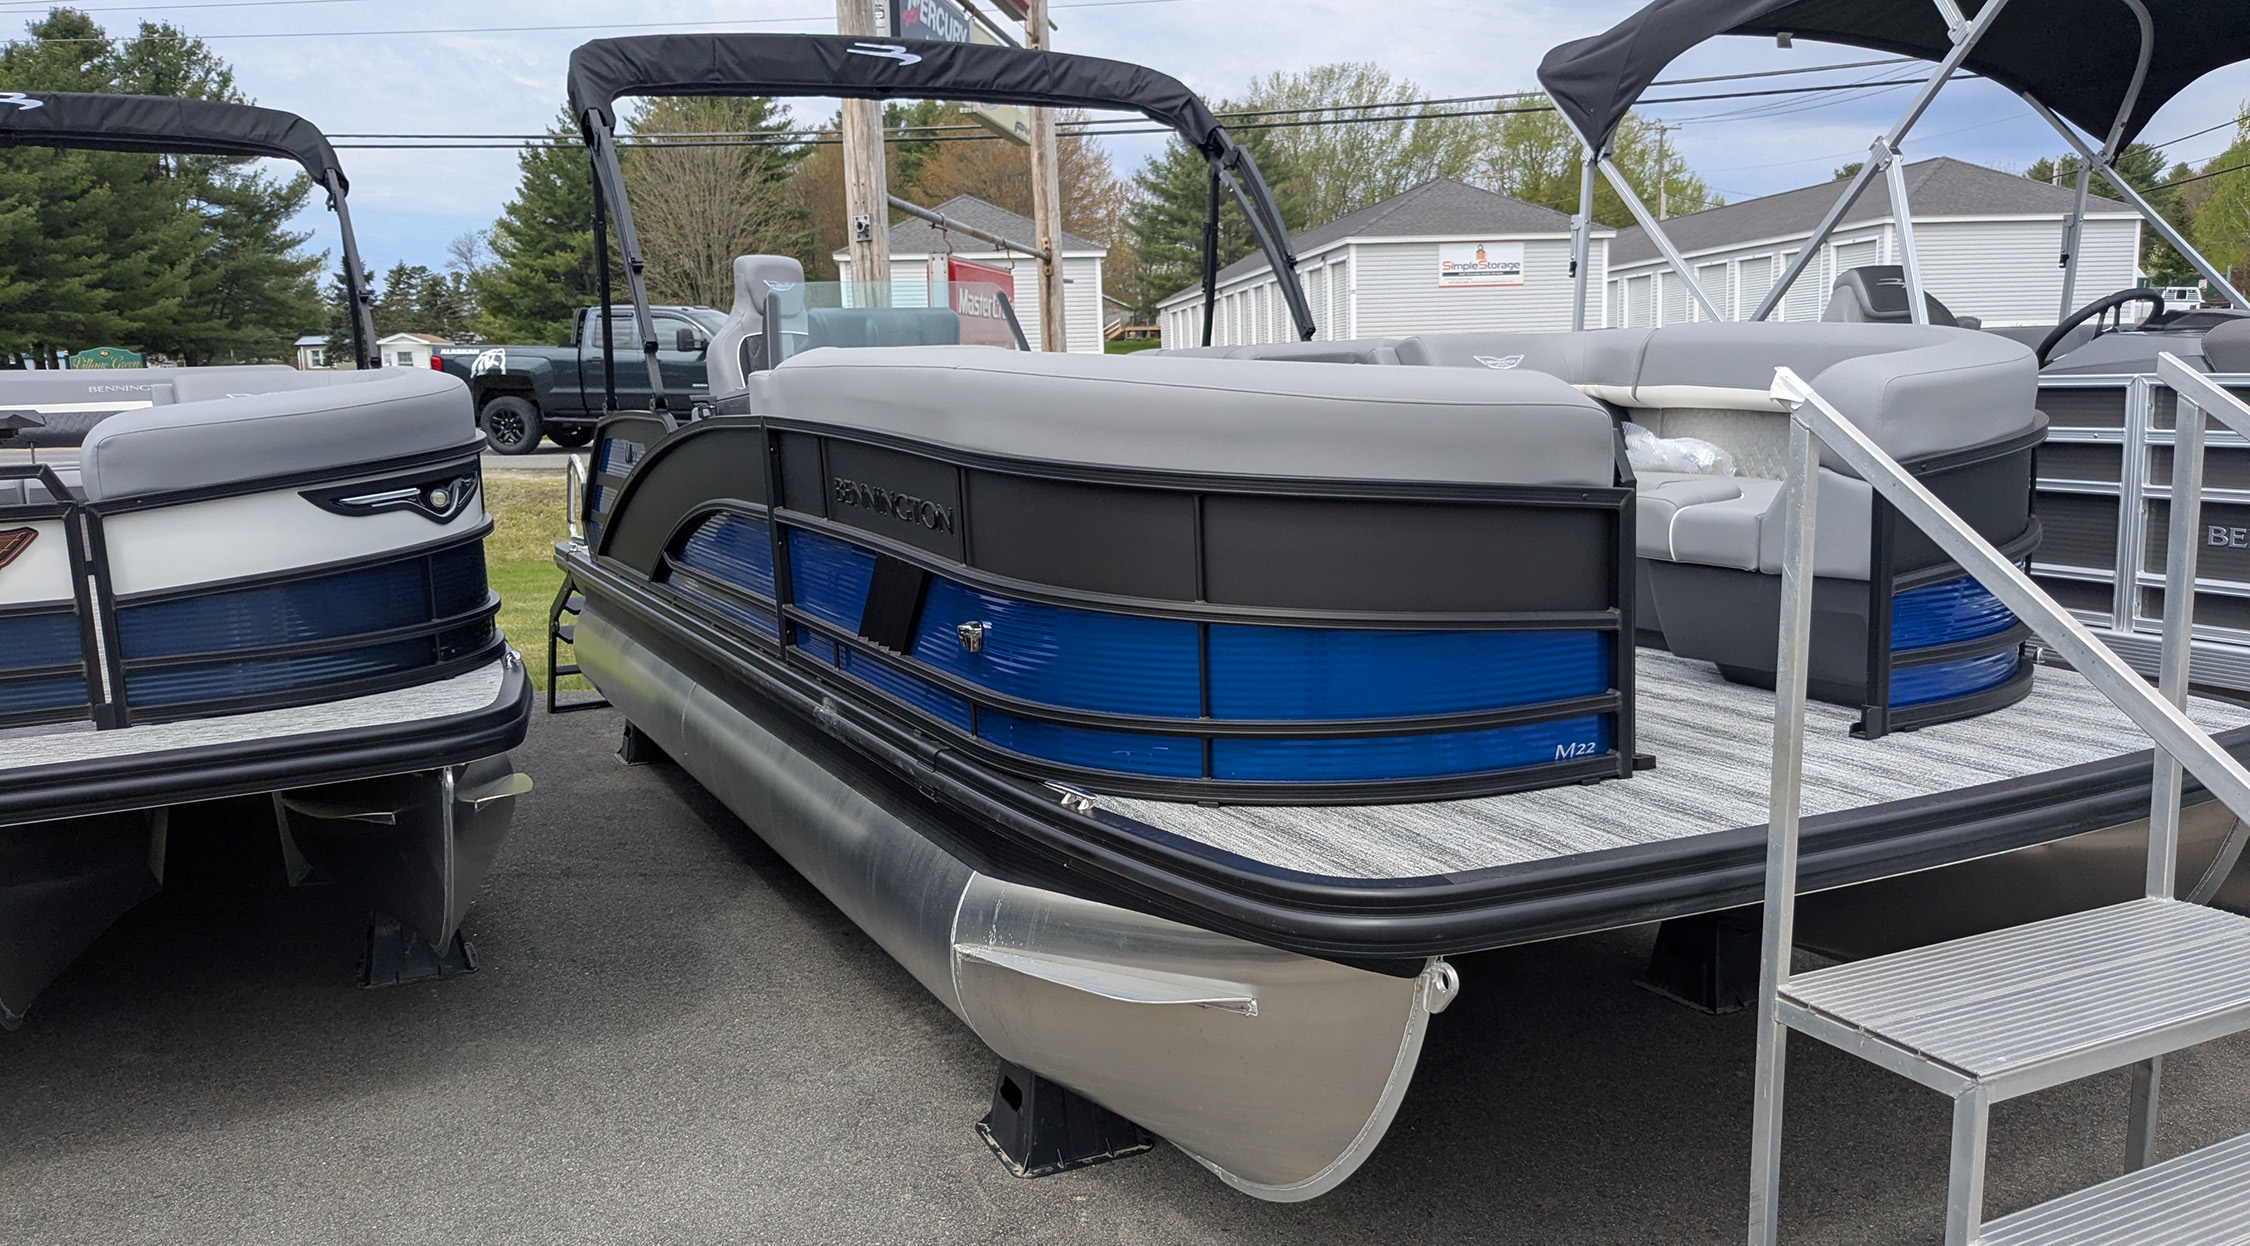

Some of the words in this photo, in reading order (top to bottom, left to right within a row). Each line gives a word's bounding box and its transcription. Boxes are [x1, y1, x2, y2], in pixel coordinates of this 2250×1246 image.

[1442, 260, 1520, 271] SimpleStorage
[88, 384, 152, 393] BENNING
[834, 477, 956, 537] BENNINGTON
[2207, 525, 2250, 549] BE
[1554, 742, 1596, 760] M22
